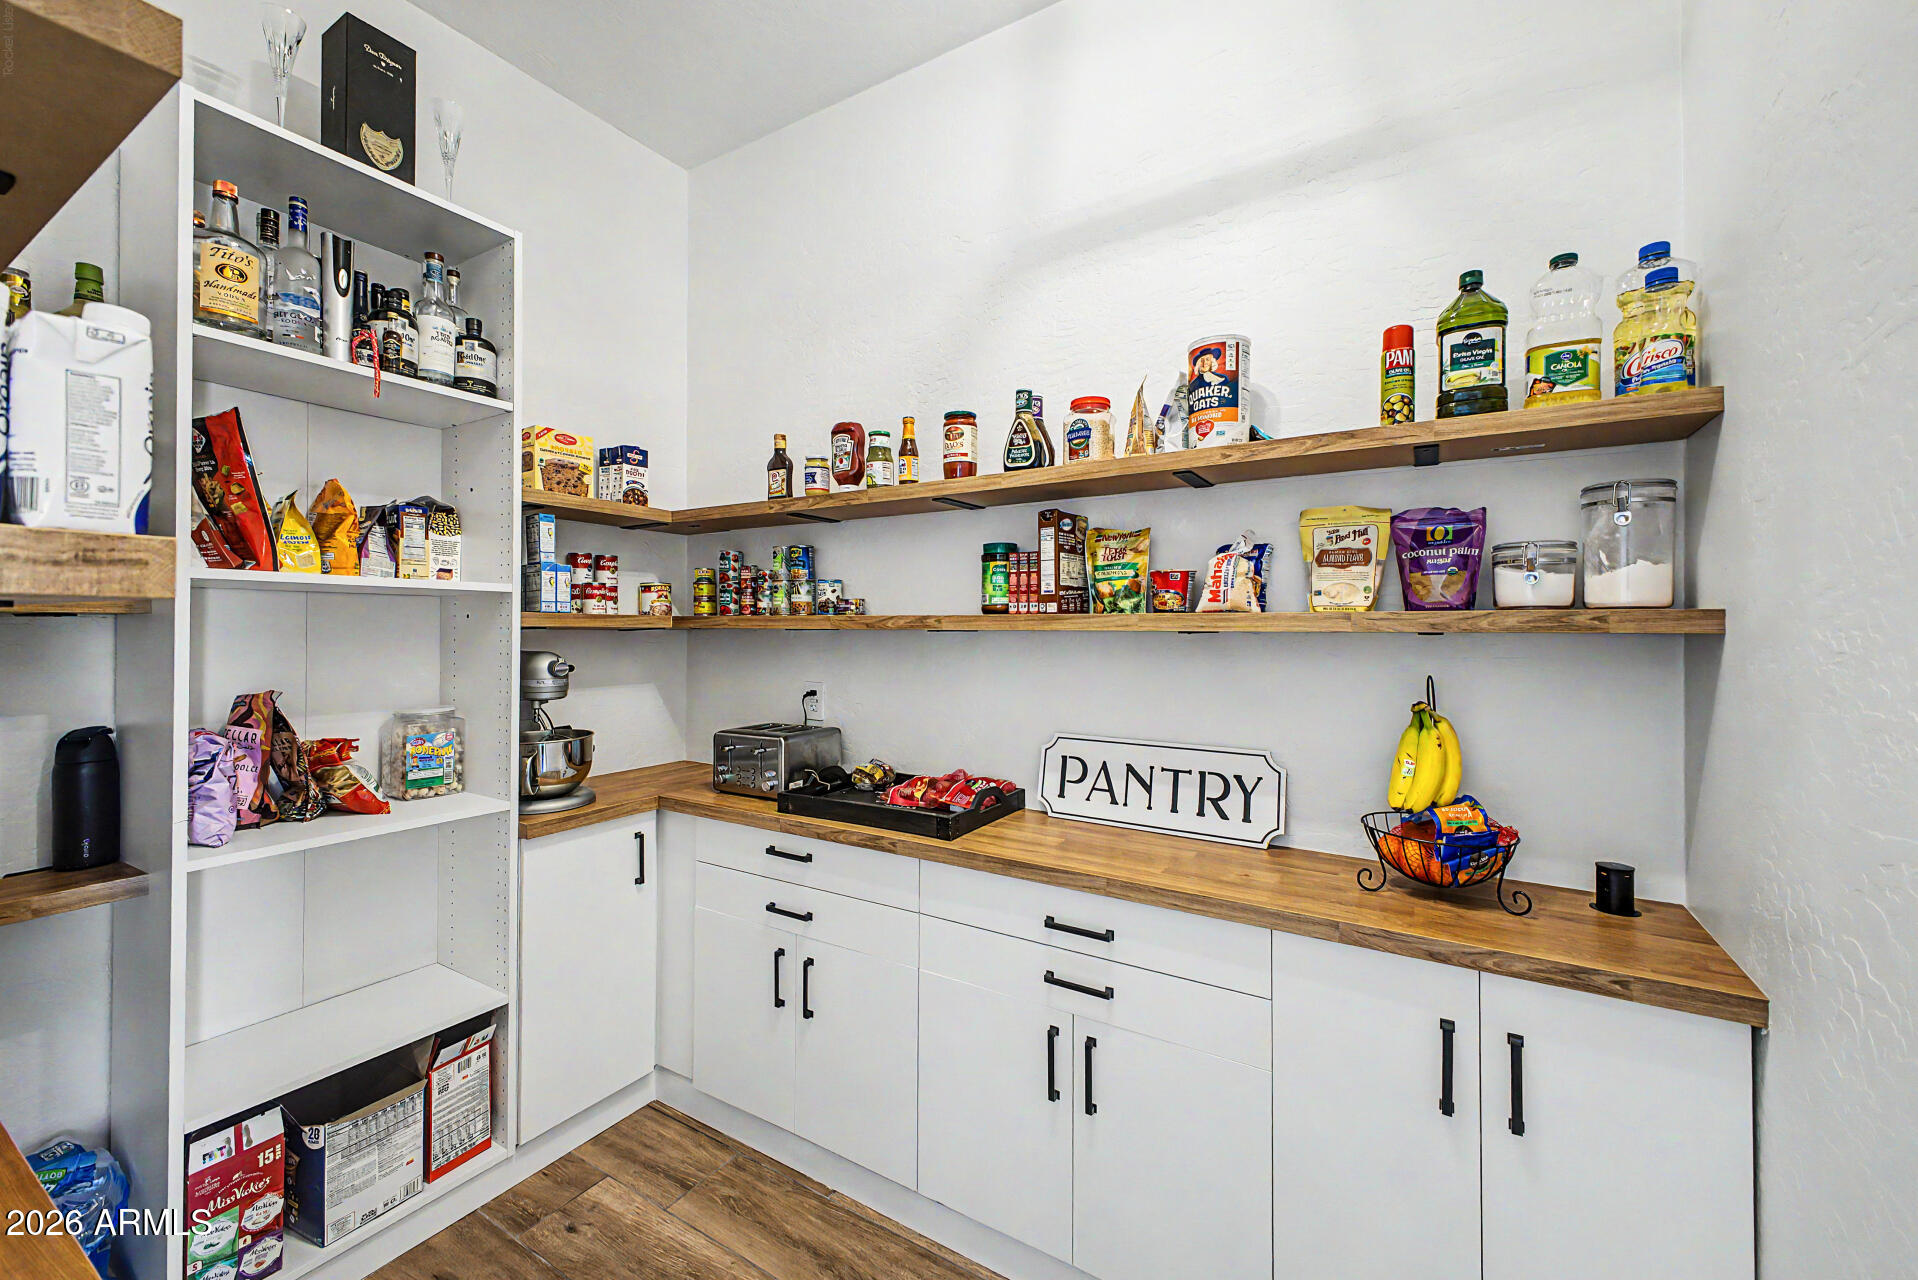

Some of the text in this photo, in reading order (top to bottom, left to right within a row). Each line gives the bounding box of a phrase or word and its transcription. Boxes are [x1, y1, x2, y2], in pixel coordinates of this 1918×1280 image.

[209, 246, 254, 270] Tito's
[1386, 349, 1413, 369] PAM
[1550, 361, 1583, 371] CANOLA
[1626, 346, 1679, 378] Crisco
[1188, 385, 1231, 405] QUAKER
[1193, 397, 1219, 411] OATS
[1401, 546, 1480, 559] coconut palm
[224, 728, 258, 745] ELLAR
[1057, 755, 1264, 824] PANTRY
[256, 1147, 275, 1169] 15
[206, 1195, 236, 1213] Miss
[231, 1175, 273, 1200] Vickie's
